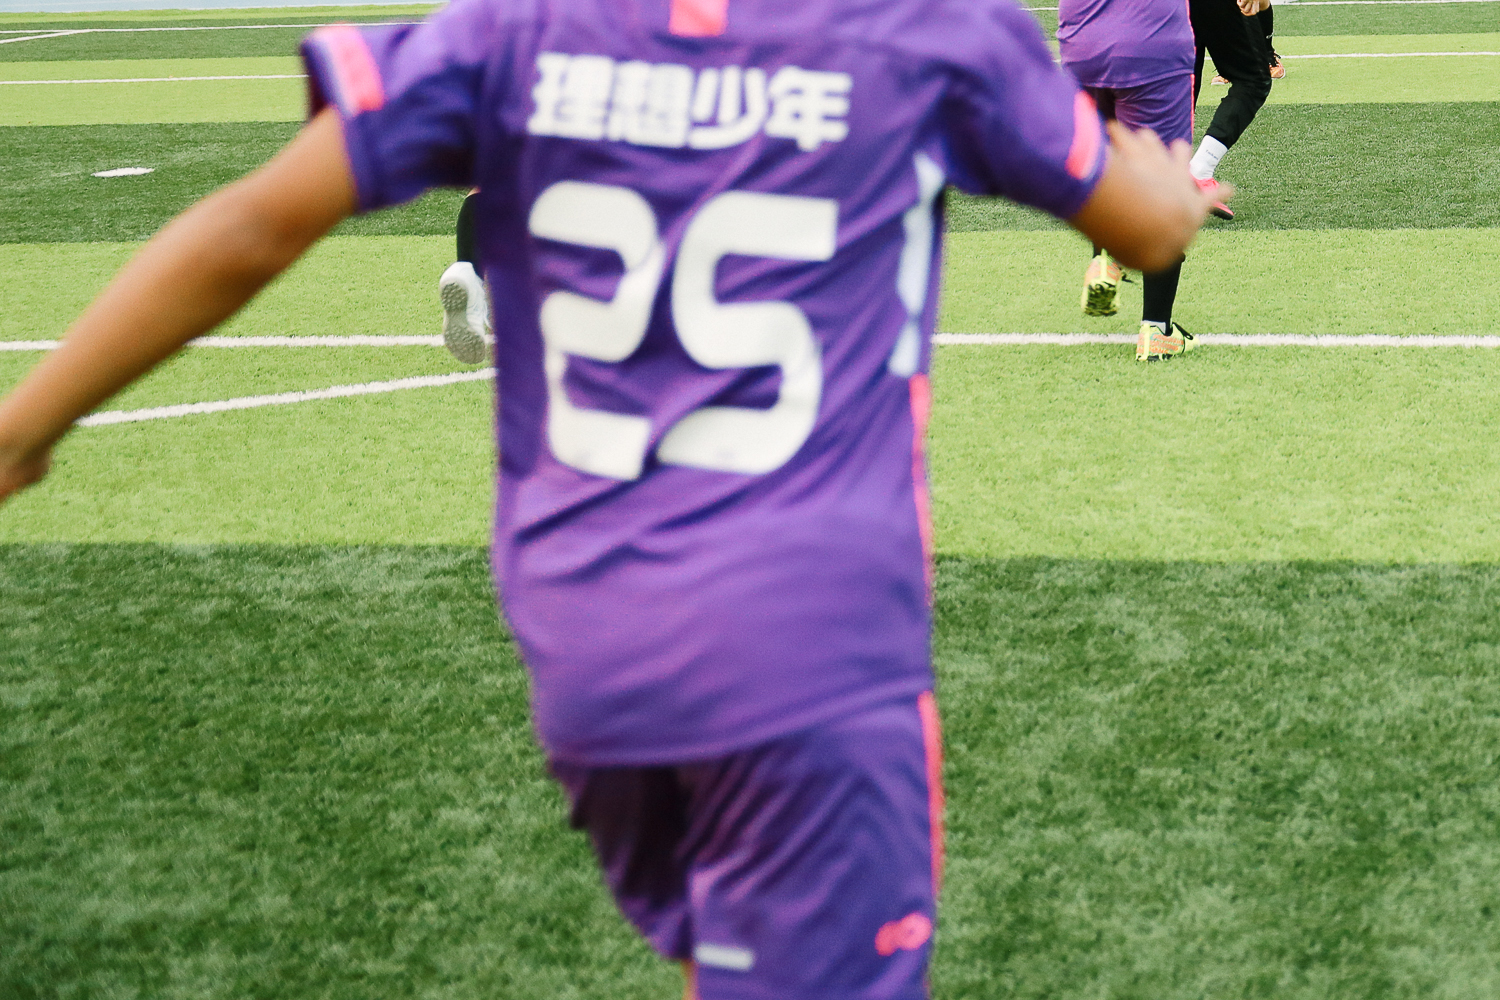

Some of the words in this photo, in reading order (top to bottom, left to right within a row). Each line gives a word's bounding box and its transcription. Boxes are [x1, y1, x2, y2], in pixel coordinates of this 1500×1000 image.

[527, 51, 852, 152] 理想少年
[528, 180, 840, 481] 25
